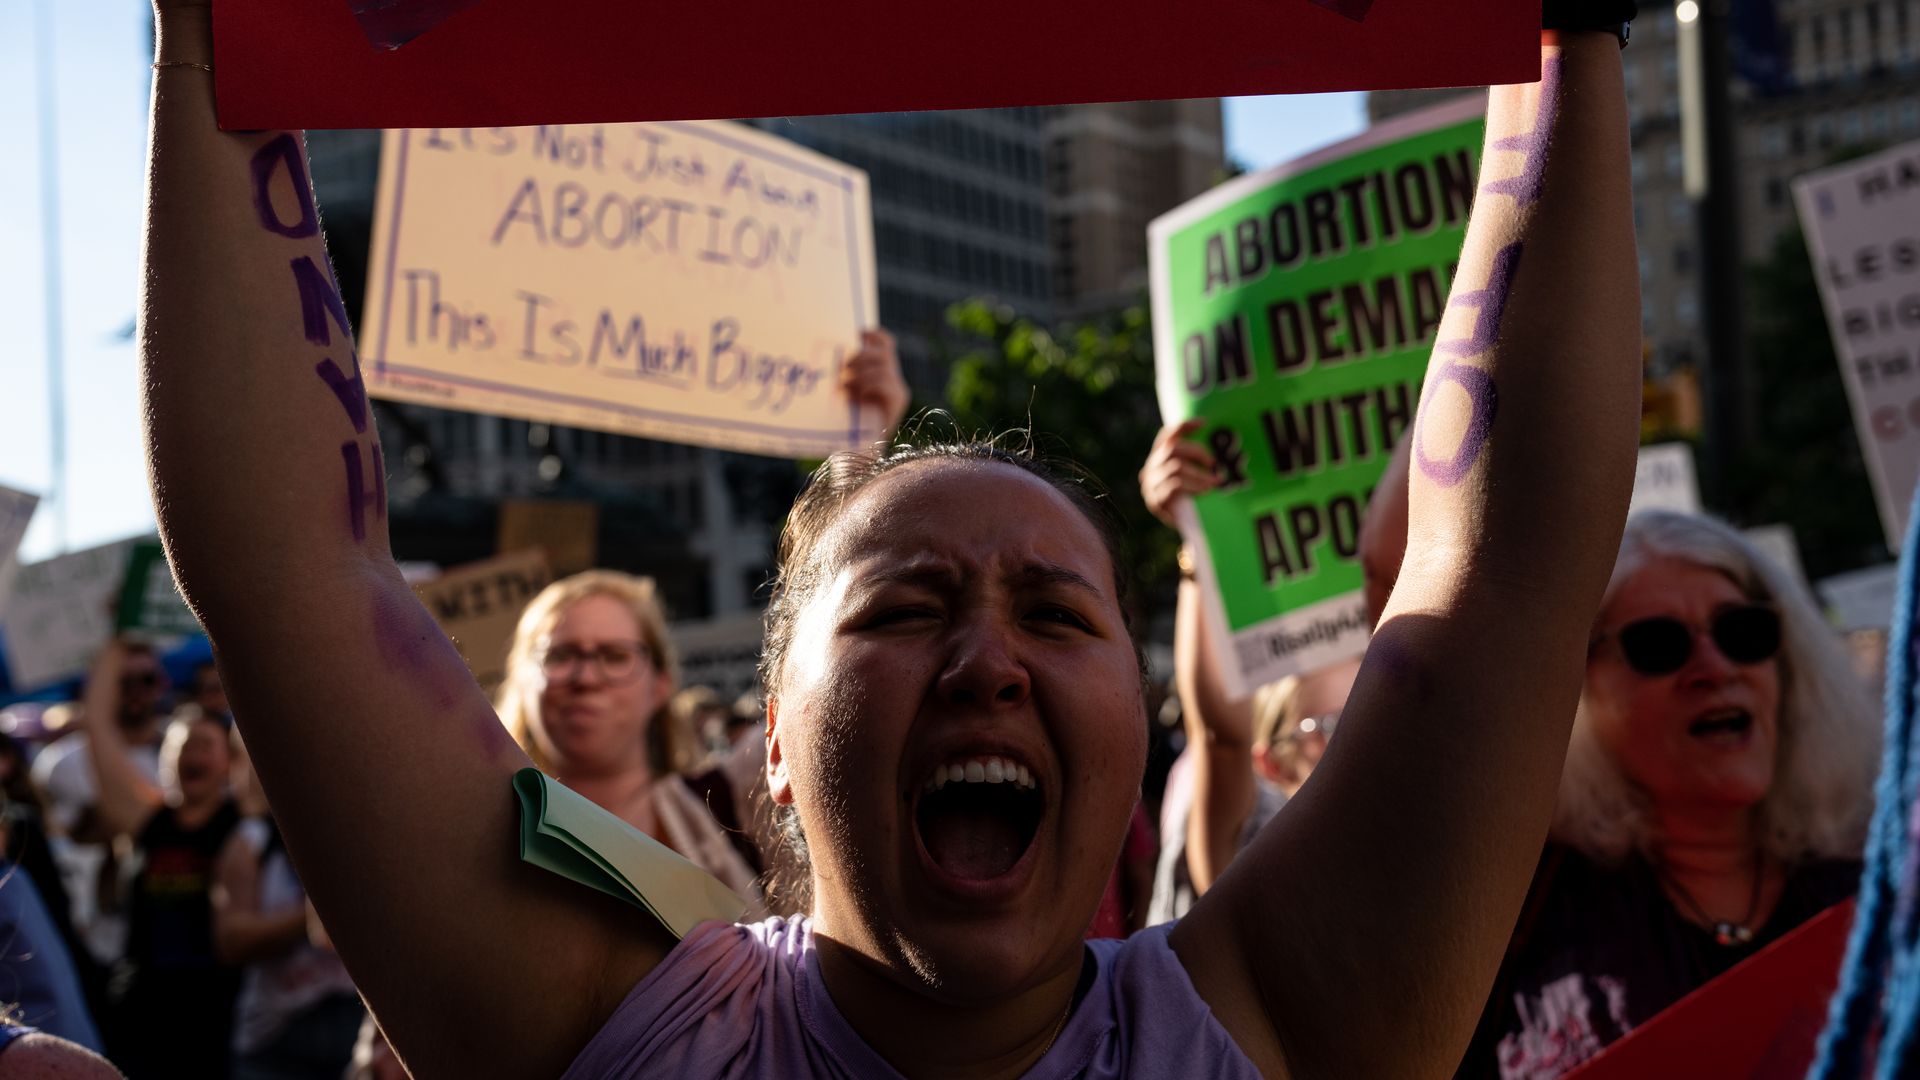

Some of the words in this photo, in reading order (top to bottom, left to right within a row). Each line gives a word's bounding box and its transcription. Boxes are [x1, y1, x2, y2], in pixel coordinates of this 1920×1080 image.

[532, 124, 605, 172] Not
[489, 176, 803, 270] ABORTION
[1203, 149, 1476, 293] ABORTION
[401, 268, 496, 352] This
[516, 288, 583, 366] Is
[587, 307, 699, 374] Much
[1183, 311, 1254, 393] ON
[1267, 262, 1457, 375] DEMA
[1209, 425, 1245, 490] &
[1262, 382, 1420, 475] WITH
[1255, 488, 1375, 587] APO
